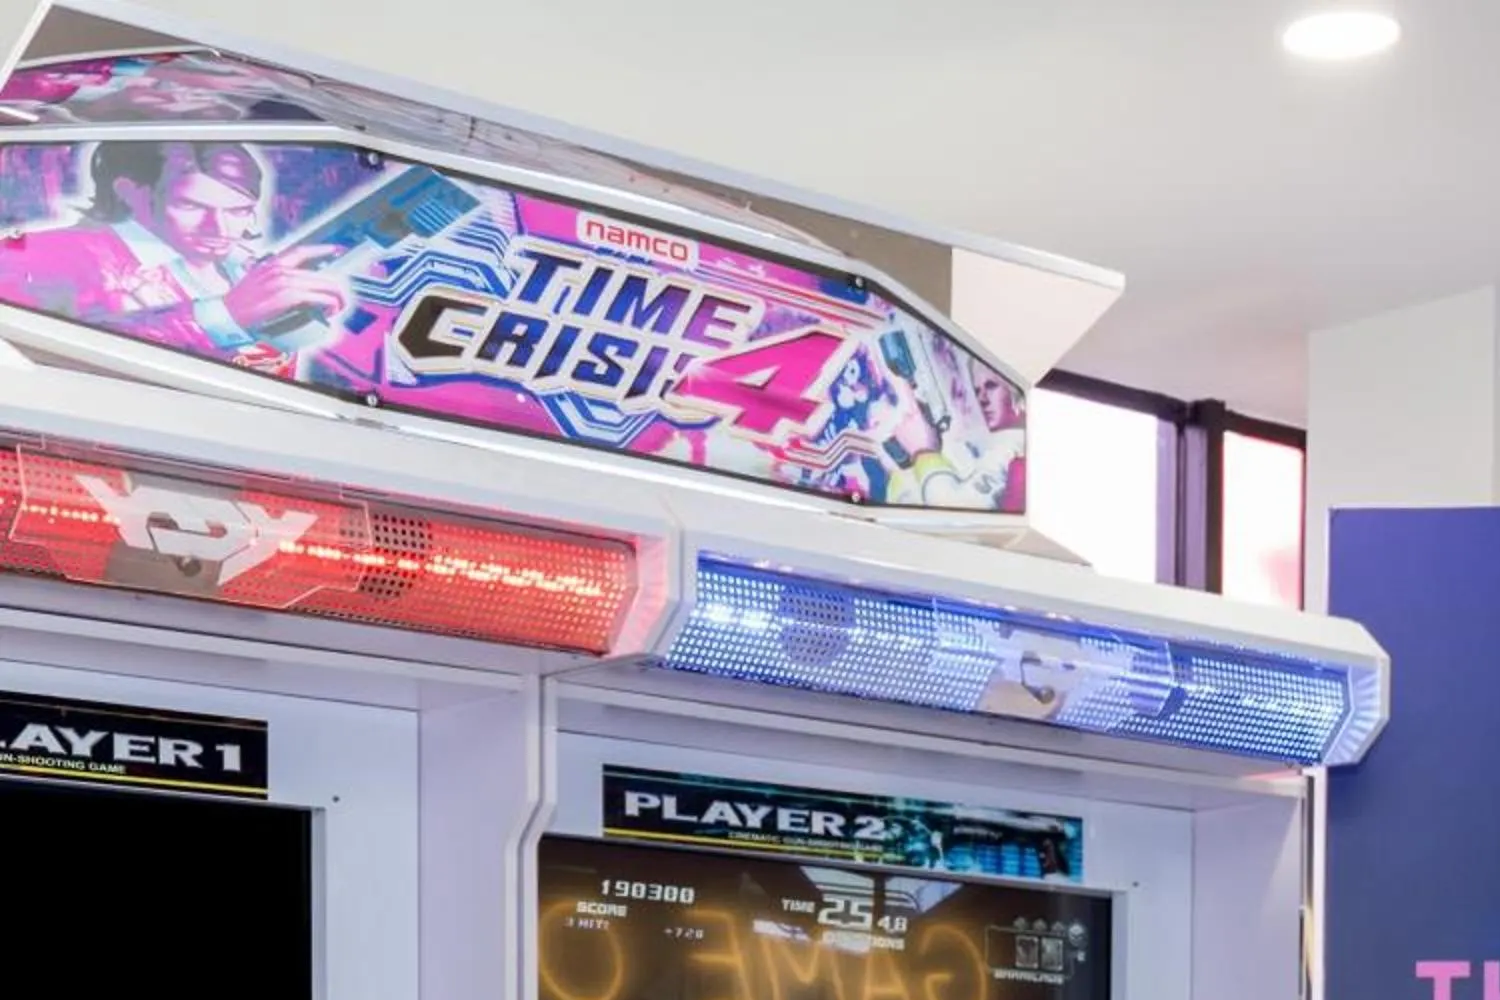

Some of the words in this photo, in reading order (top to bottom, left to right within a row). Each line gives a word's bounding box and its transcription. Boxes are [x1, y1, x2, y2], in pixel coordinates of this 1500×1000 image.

[586, 219, 689, 263] namco
[517, 251, 753, 348] TIME
[671, 328, 846, 431] 4
[0, 722, 204, 769] AYER
[215, 743, 242, 773] 1
[624, 790, 847, 837] PLAYER
[853, 815, 887, 841] 2
[576, 901, 629, 917] SCORE
[601, 879, 696, 905] 190300
